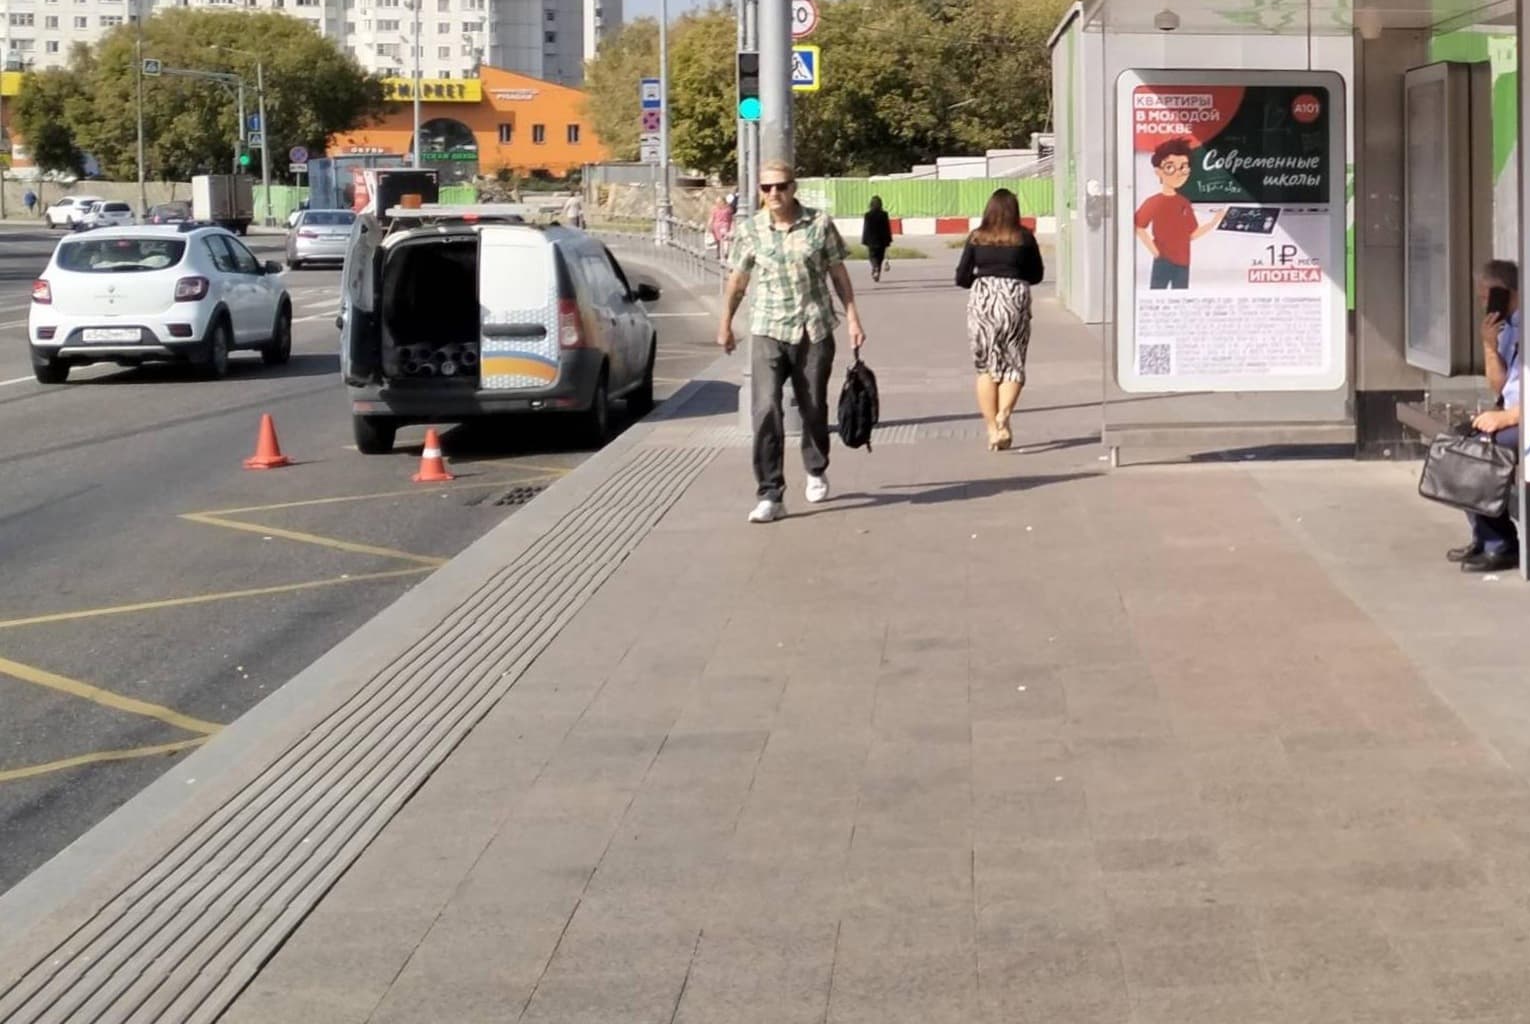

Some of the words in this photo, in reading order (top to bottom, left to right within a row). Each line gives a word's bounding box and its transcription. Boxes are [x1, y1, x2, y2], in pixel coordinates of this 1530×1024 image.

[791, 6, 808, 24] 0
[1135, 95, 1212, 107] КВАРТИРЫ
[1135, 110, 1146, 122] В
[1148, 108, 1221, 122] МОЛОДОЙ
[1135, 123, 1192, 134] МОСКВЕ
[1202, 148, 1321, 172] Современные
[1262, 172, 1321, 187] школы
[1249, 269, 1320, 282] ИПОТЕКА
